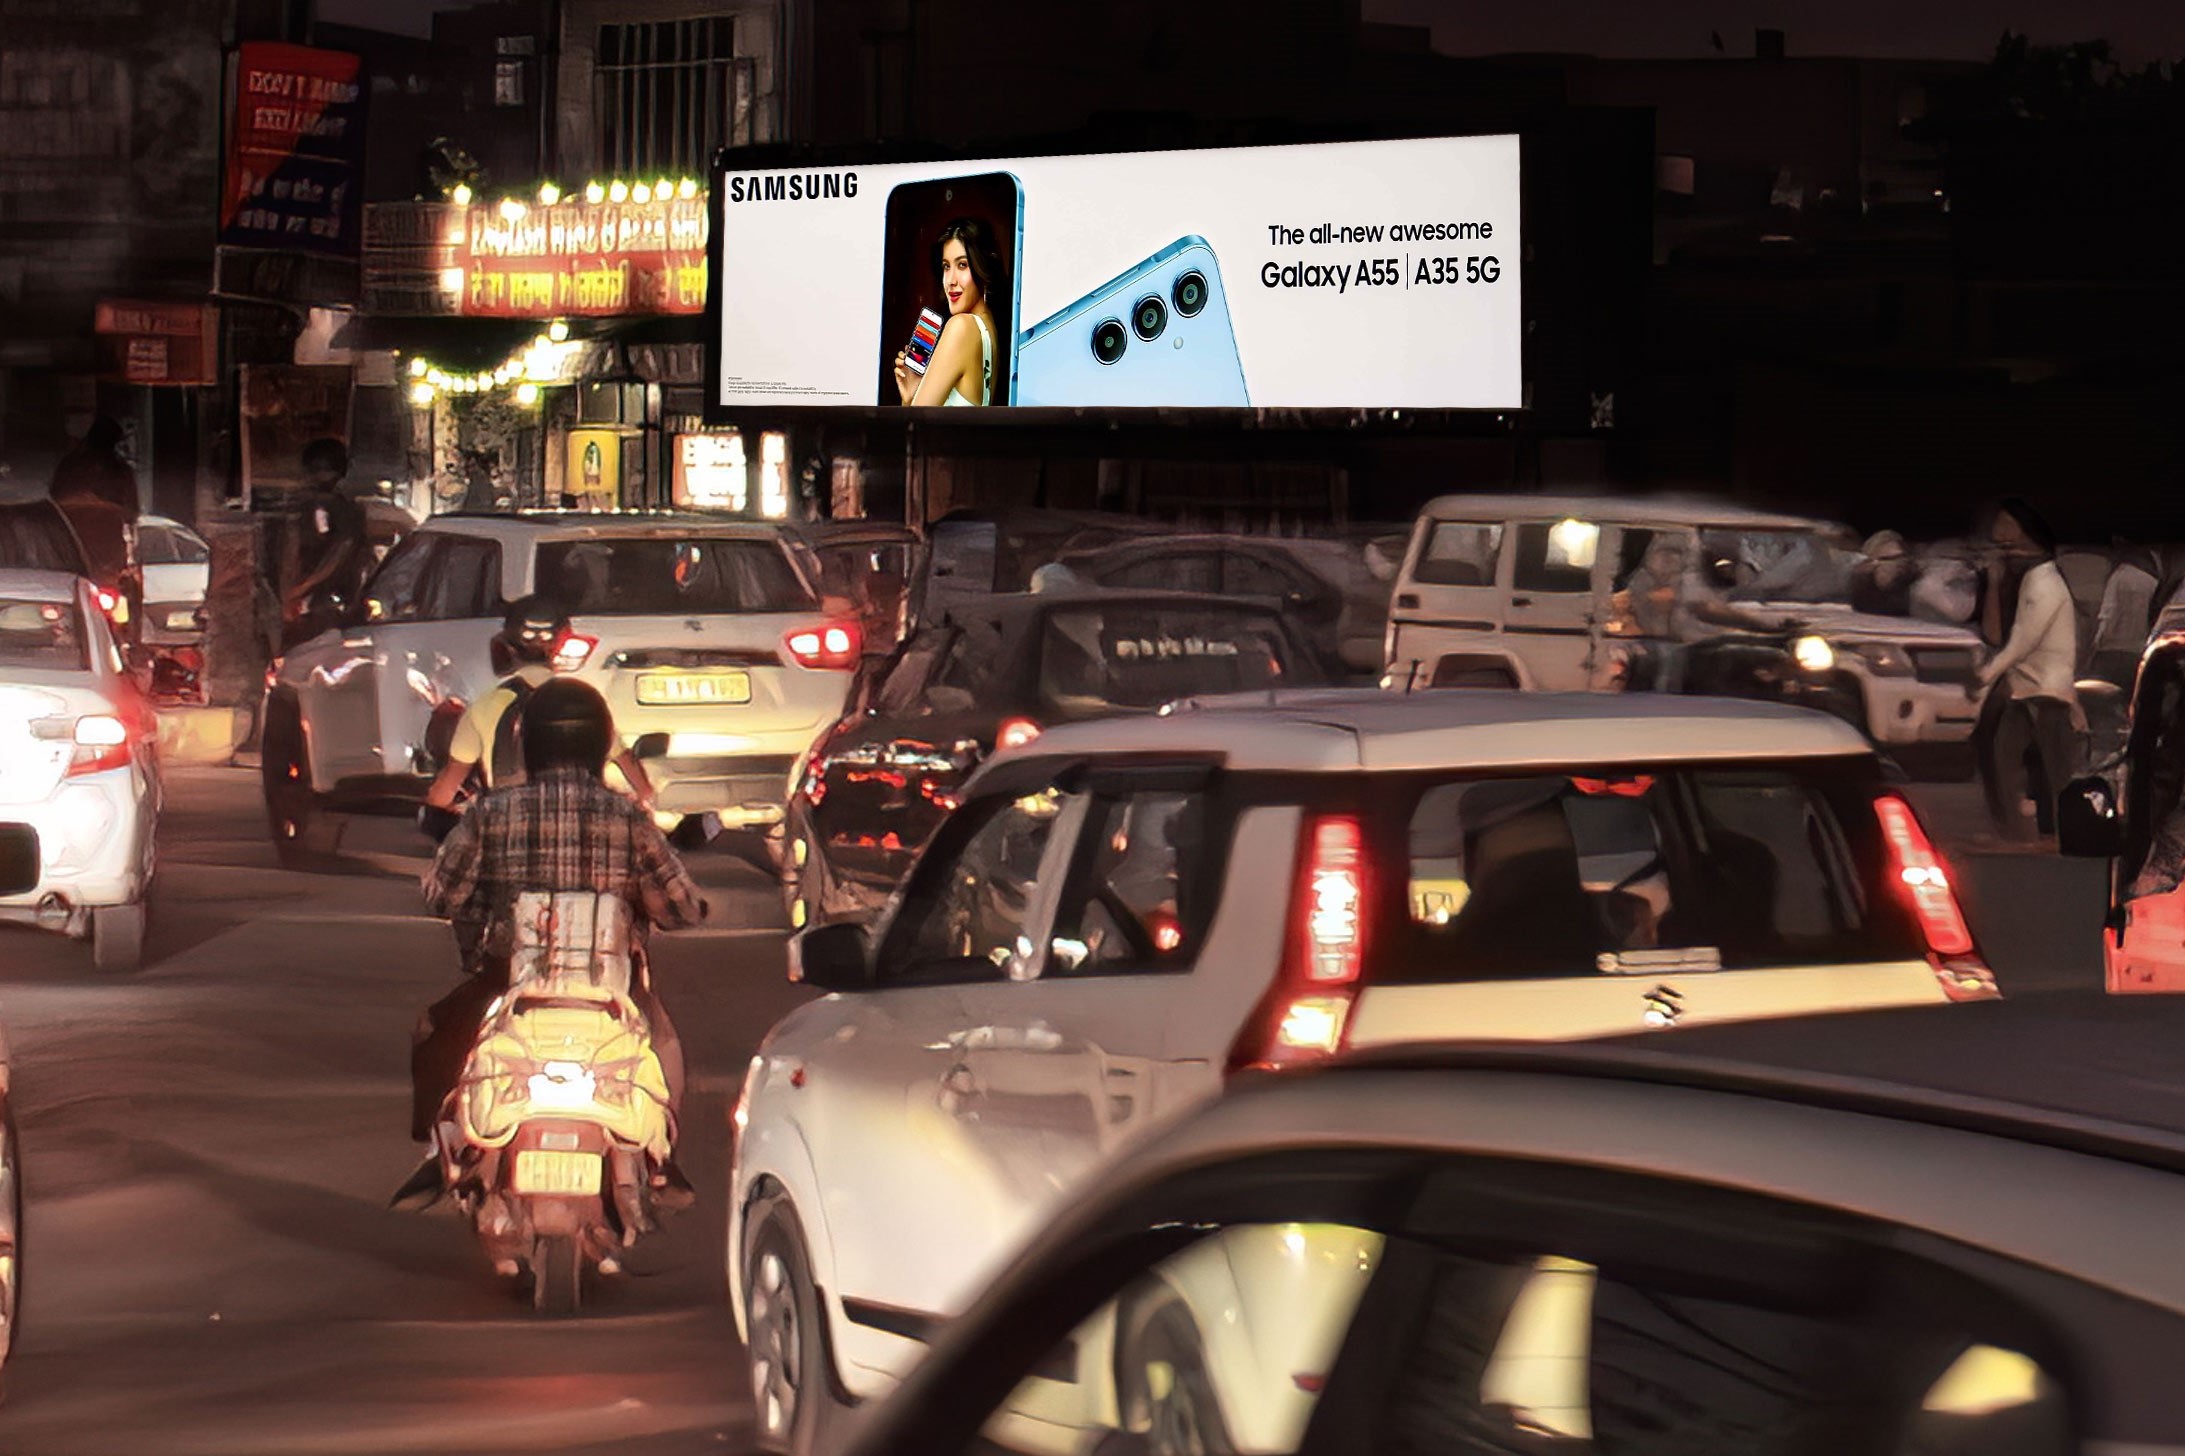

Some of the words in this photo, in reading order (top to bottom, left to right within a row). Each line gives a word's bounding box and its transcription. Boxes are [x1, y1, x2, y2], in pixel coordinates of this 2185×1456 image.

[730, 172, 858, 203] SAMSUNG
[1268, 224, 1305, 246] The
[1309, 223, 1385, 245] all-new
[1389, 221, 1493, 242] awesome
[1261, 260, 1352, 295] Galaxy
[1354, 258, 1400, 287] A55
[1414, 256, 1459, 285] A35
[1466, 255, 1501, 284] 5G
